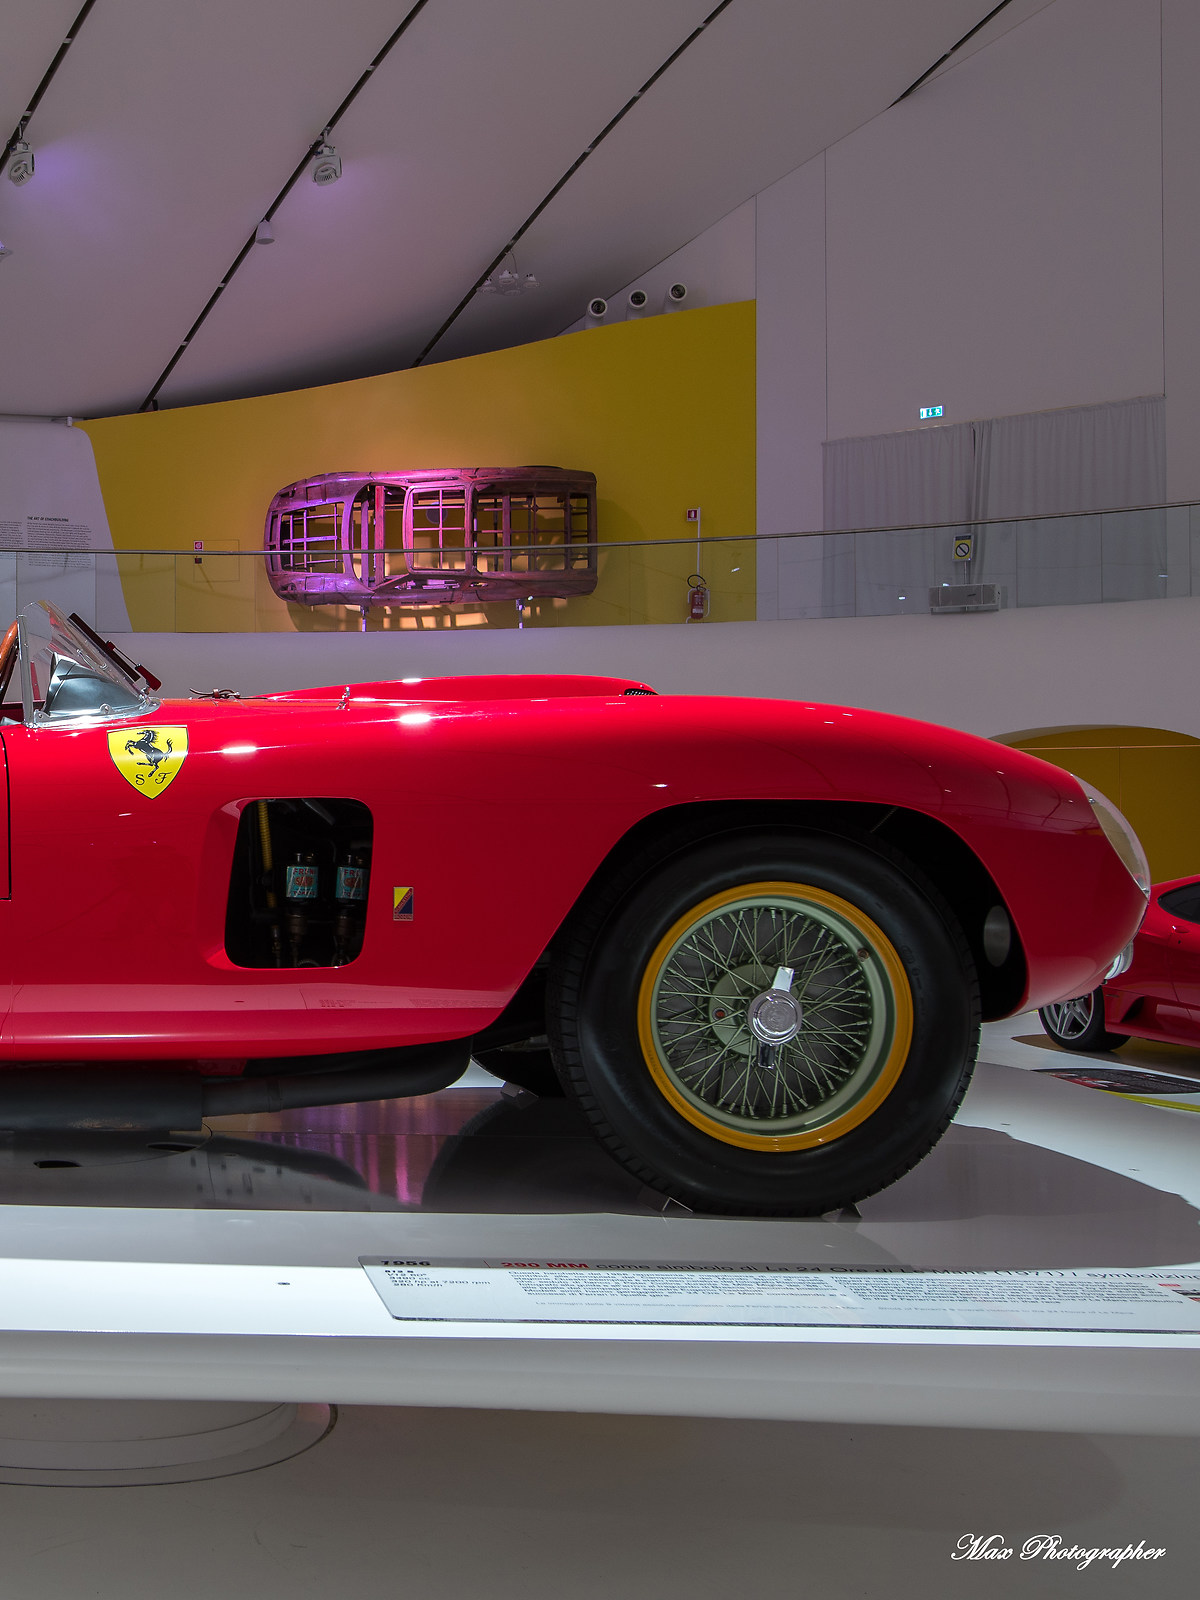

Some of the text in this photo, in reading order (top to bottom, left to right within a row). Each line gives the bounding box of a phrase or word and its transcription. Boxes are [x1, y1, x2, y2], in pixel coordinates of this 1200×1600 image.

[135, 772, 173, 786] S F
[380, 1259, 432, 1267] 1956
[501, 1261, 541, 1269] 290
[545, 1262, 590, 1270] MM
[657, 1263, 734, 1271] simbolo
[740, 1264, 759, 1272] di
